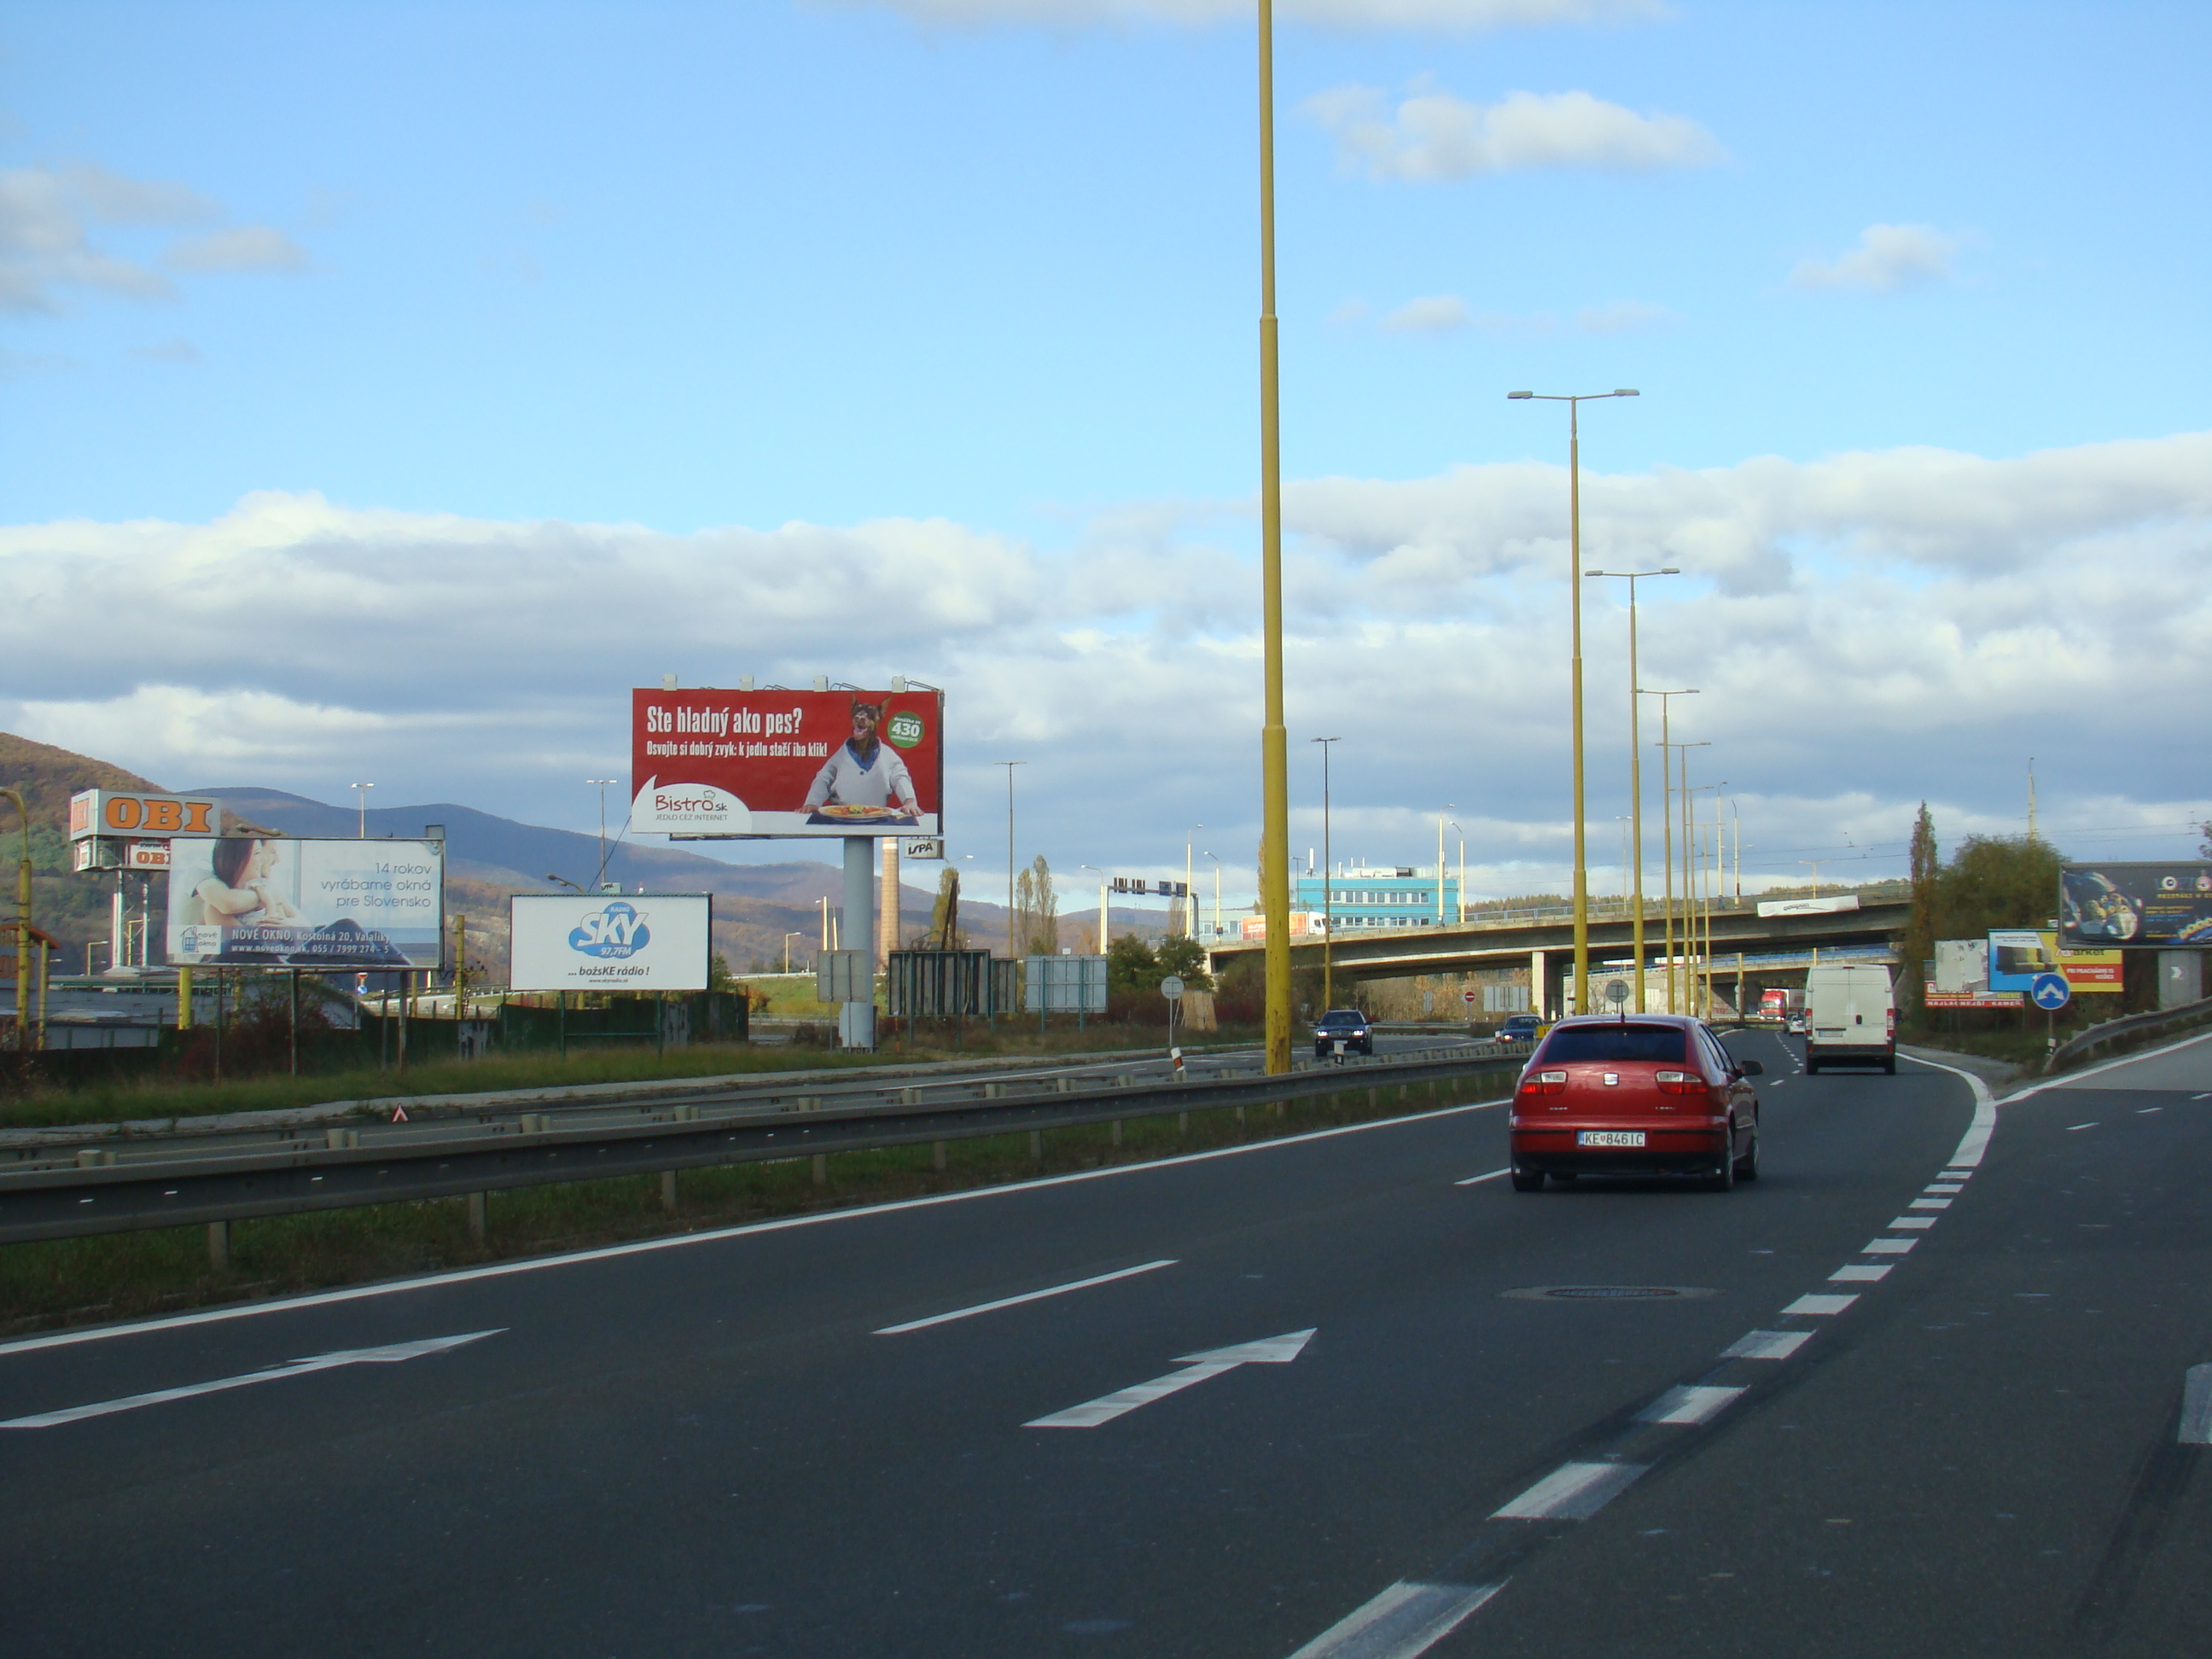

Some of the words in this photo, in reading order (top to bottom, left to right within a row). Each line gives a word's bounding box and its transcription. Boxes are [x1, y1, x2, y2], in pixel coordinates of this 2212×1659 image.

[646, 705, 672, 732] Ste
[677, 706, 730, 737] hladný
[732, 707, 760, 734] ako
[765, 707, 803, 737] pes?
[891, 721, 920, 737] 430
[647, 740, 678, 758] Osvojte
[679, 741, 688, 755] si
[690, 741, 713, 758] dobrý
[715, 743, 737, 759] zvyk:
[739, 742, 745, 756] k
[746, 742, 768, 758] jedlu
[769, 742, 790, 757] stačí
[793, 742, 806, 757] iba
[808, 742, 828, 757] klik!
[655, 795, 728, 812] Bistro.sk
[106, 797, 212, 833] OBI
[375, 863, 390, 874] 14
[393, 863, 432, 874] rokov
[321, 878, 393, 892] vyrábame
[396, 879, 432, 891] okná
[336, 897, 360, 908] pre
[364, 895, 431, 907] Slovensko
[232, 928, 259, 940] NOVÉ
[262, 928, 294, 941] OKNO,
[296, 931, 336, 941] Kostolná
[338, 931, 352, 942] 20,
[577, 912, 649, 946] SKY
[312, 944, 328, 953] 055
[617, 965, 644, 976] rádio
[1585, 1132, 1600, 1144] KE
